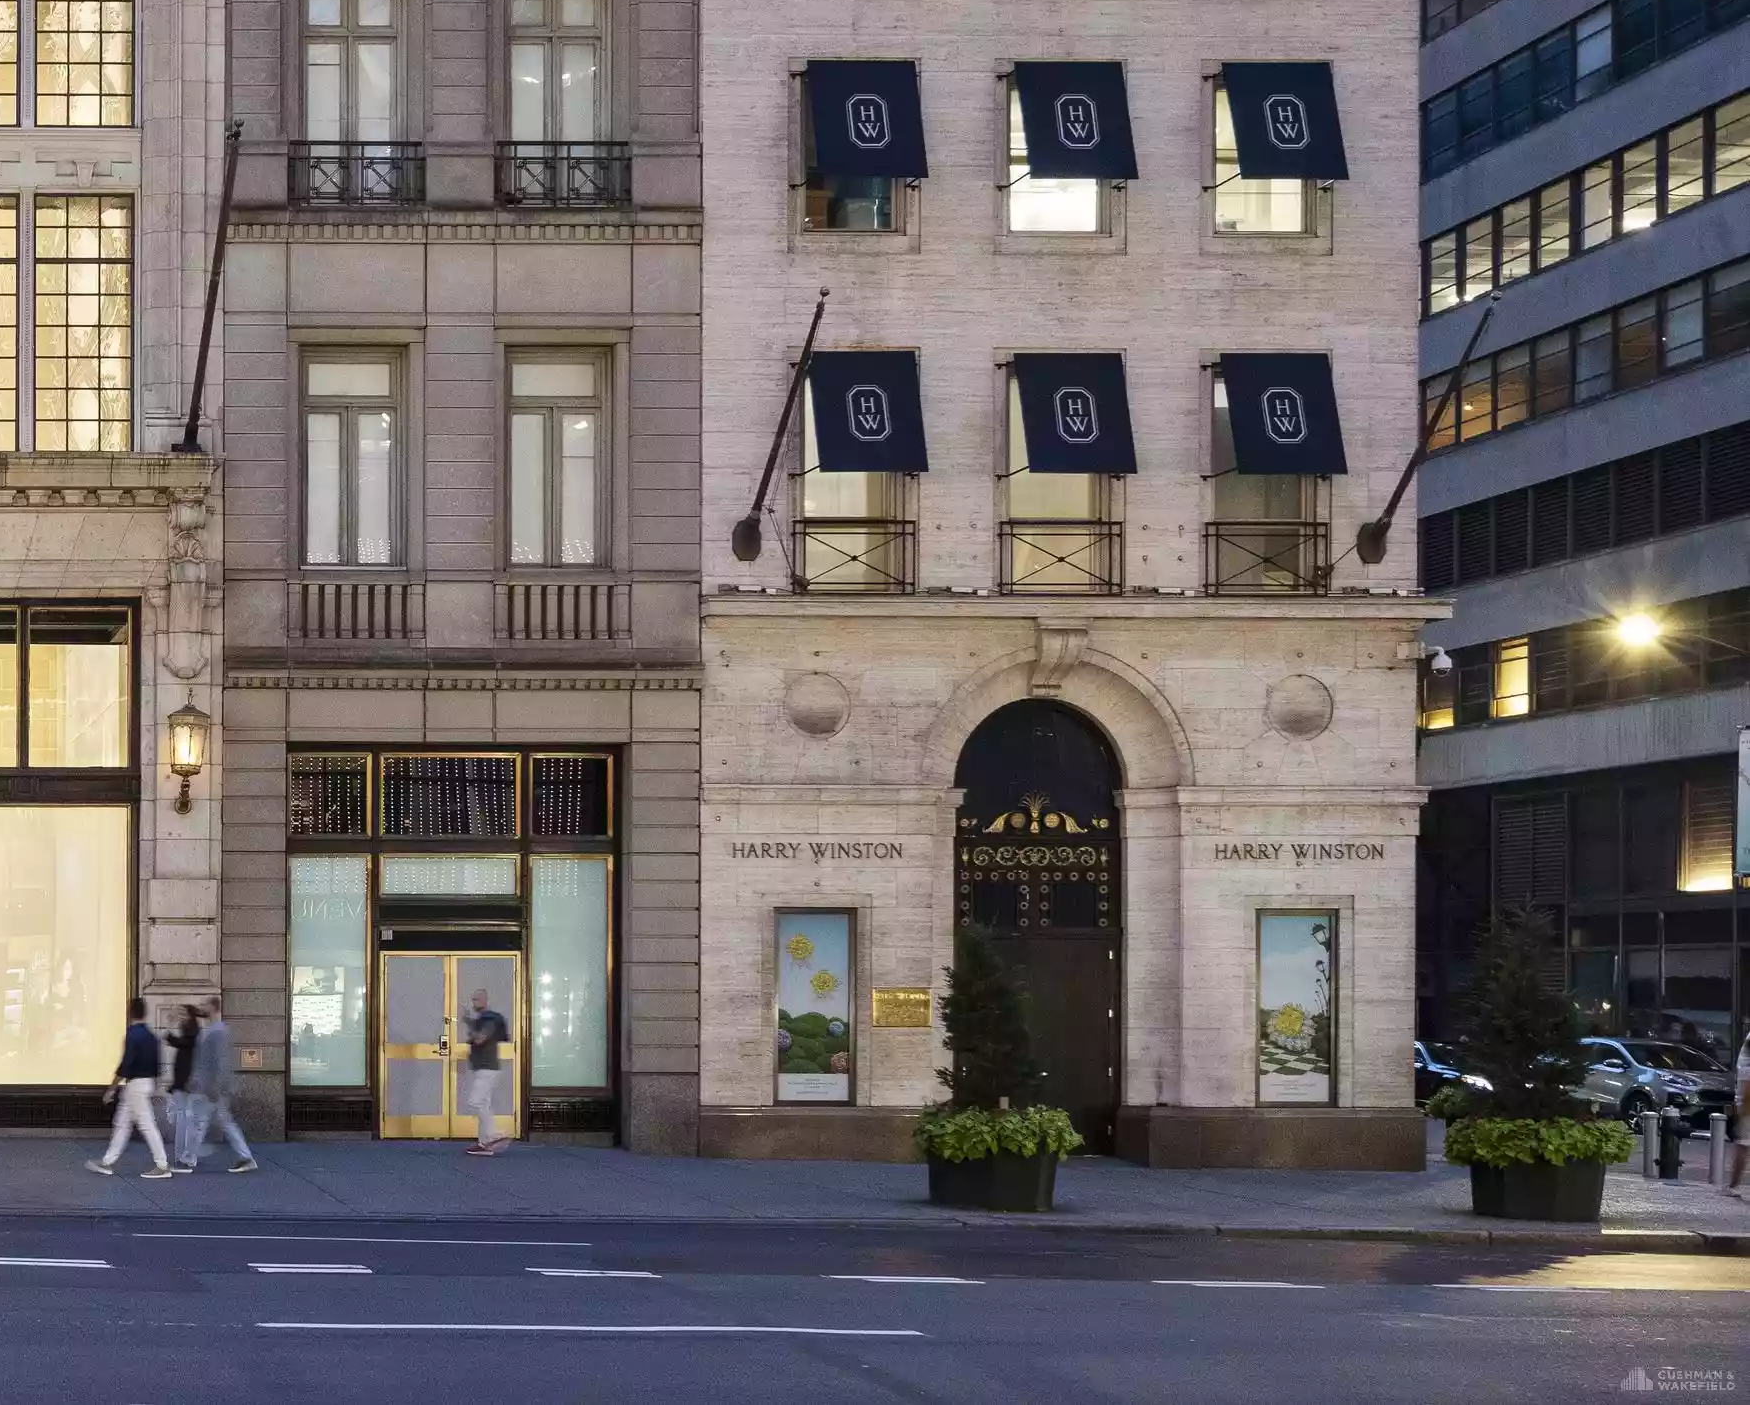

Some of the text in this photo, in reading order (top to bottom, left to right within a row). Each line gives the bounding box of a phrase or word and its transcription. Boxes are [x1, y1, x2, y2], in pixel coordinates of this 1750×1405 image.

[732, 842, 903, 859] HARRY WINSTON
[1214, 843, 1384, 860] HARRY WINSTON
